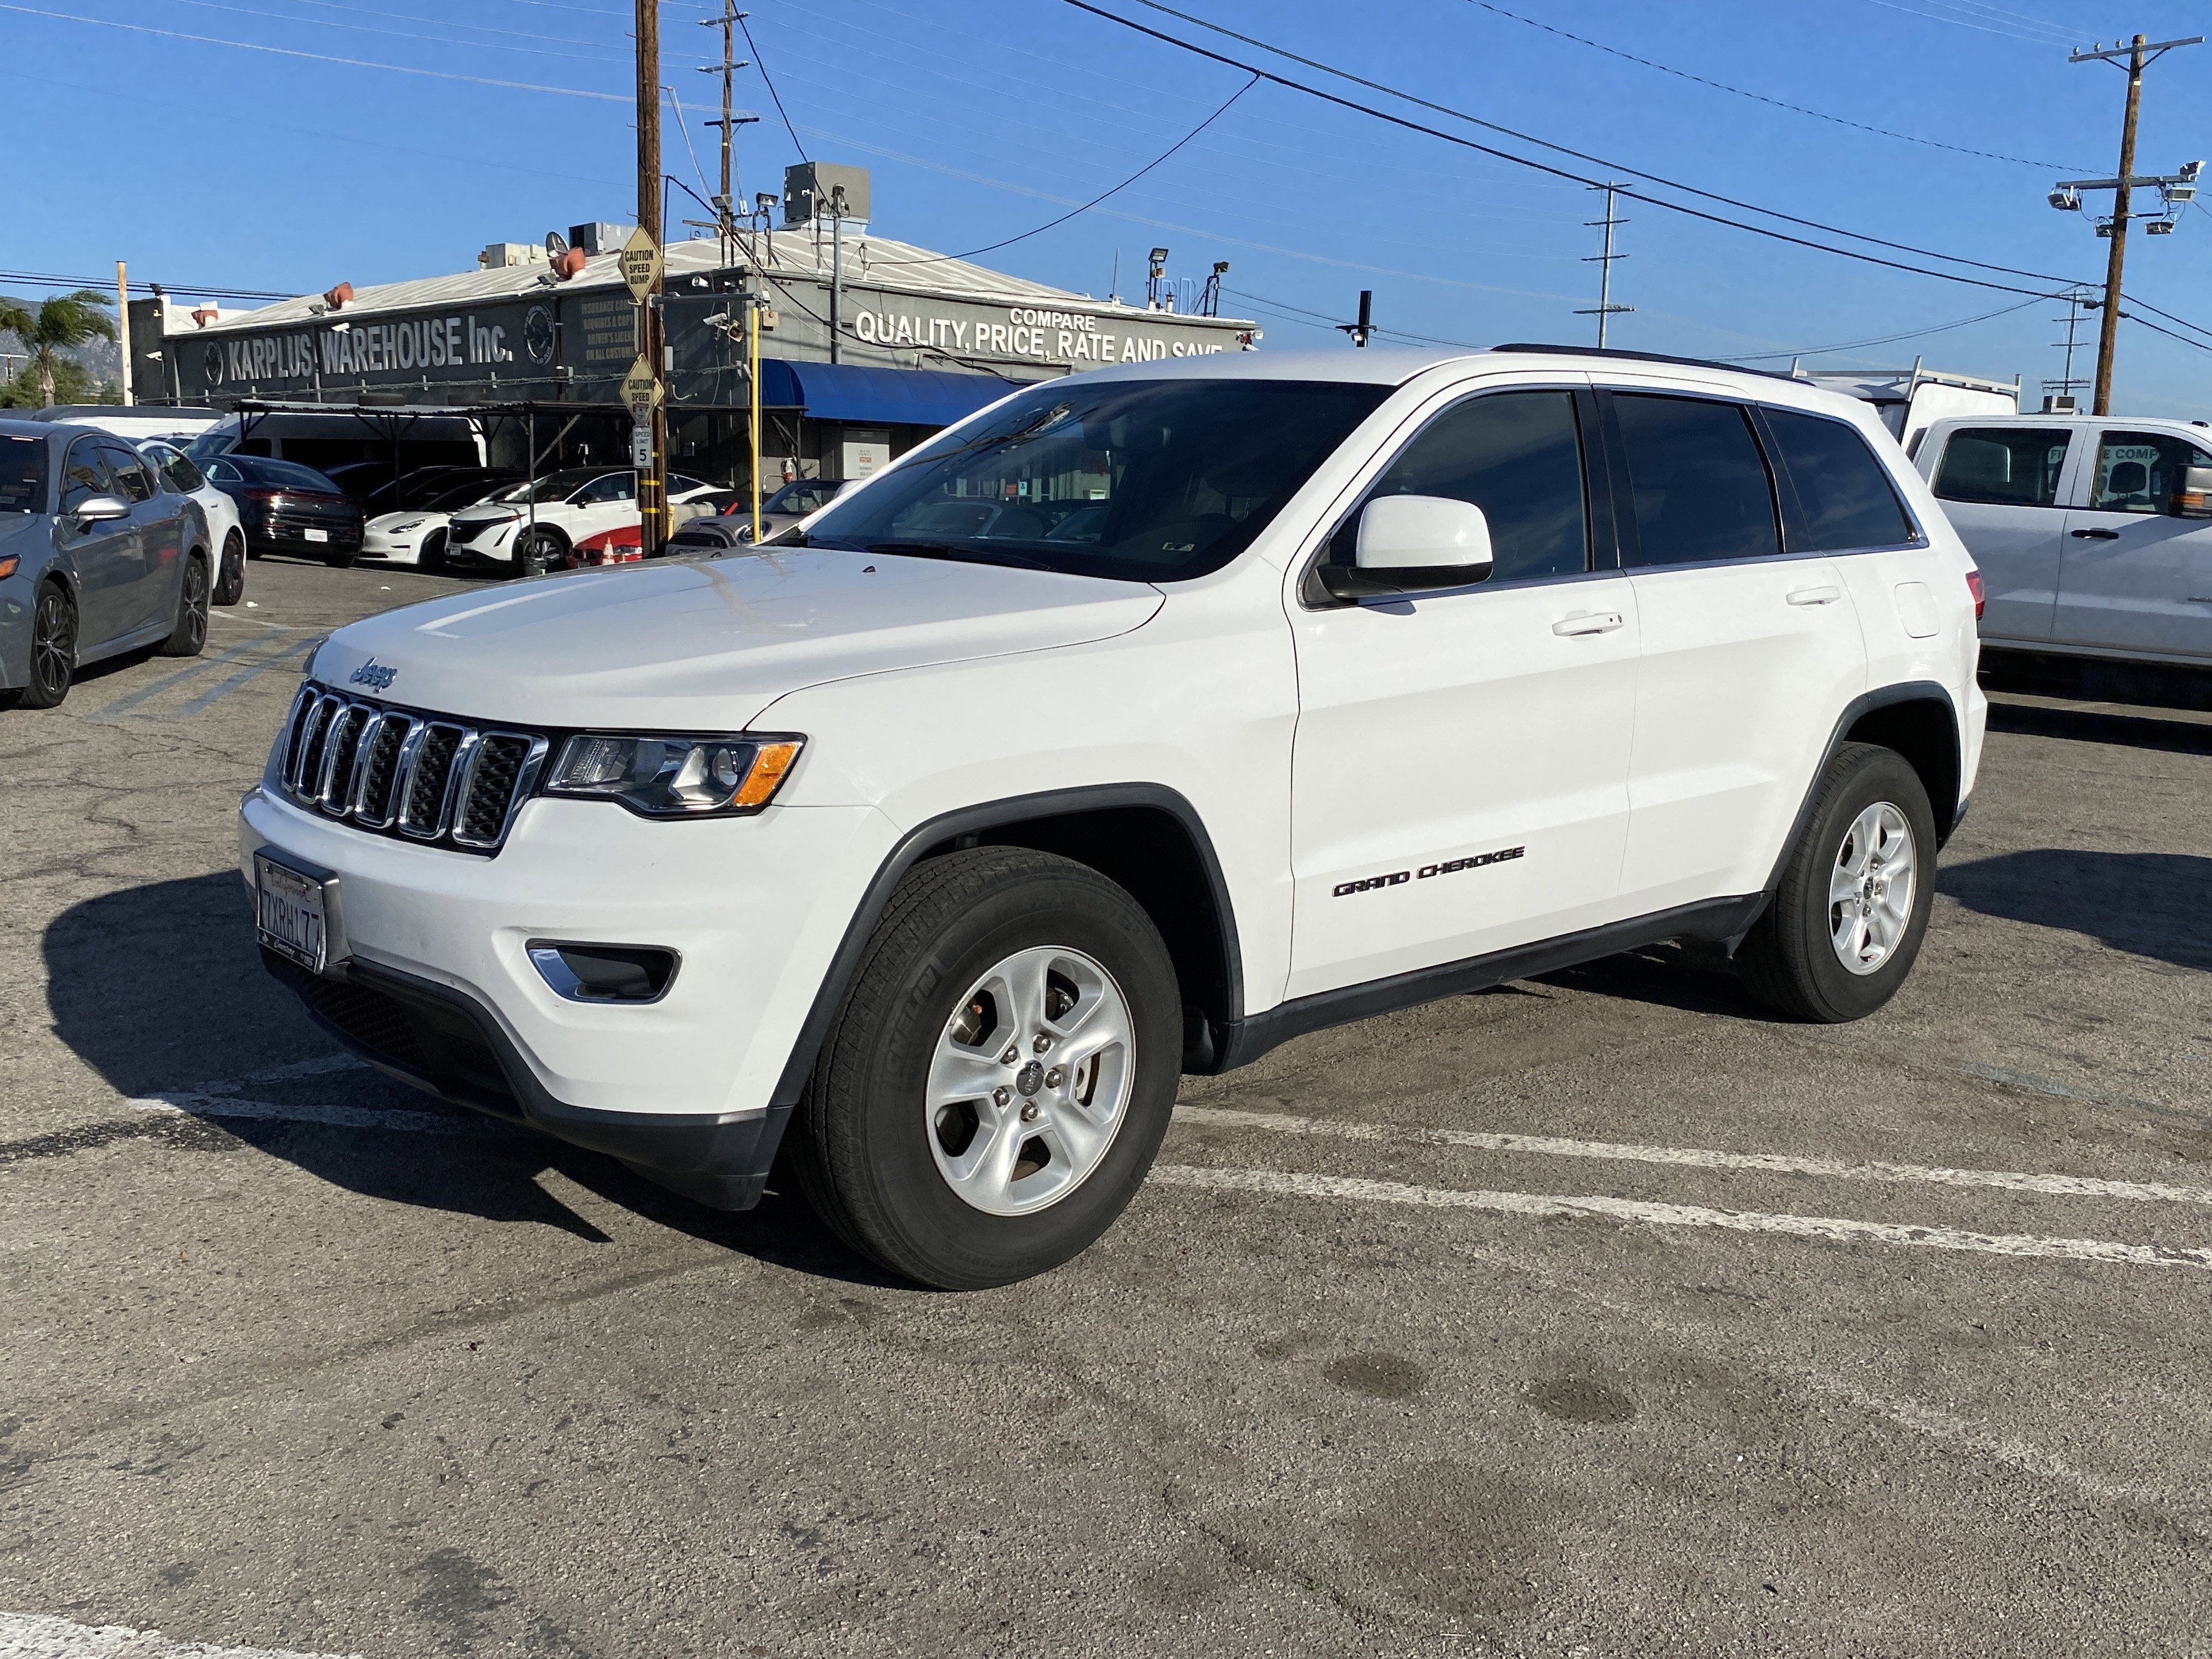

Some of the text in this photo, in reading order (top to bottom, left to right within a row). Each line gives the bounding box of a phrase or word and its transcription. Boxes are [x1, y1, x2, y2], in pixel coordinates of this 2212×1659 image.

[625, 249, 653, 262] CAUTION
[629, 263, 650, 274] SPEED
[630, 275, 650, 285] BUMP
[1009, 308, 1096, 332] COMPARE
[856, 311, 970, 354] QUALITY,
[975, 322, 1051, 362] PRICE,
[1057, 330, 1115, 362] RATE
[1121, 337, 1167, 363] AND
[229, 334, 313, 381] KARPLUS
[320, 317, 462, 375] WAREHOUSE
[469, 315, 513, 363] Inc.
[629, 379, 654, 390] CAUTION
[631, 392, 650, 402] SPEED
[633, 403, 649, 412] BP
[639, 449, 647, 462] 5
[349, 657, 398, 694] Jeep
[1332, 845, 1525, 898] GRAND CHEROKEE
[263, 889, 319, 956] 7XRH177
